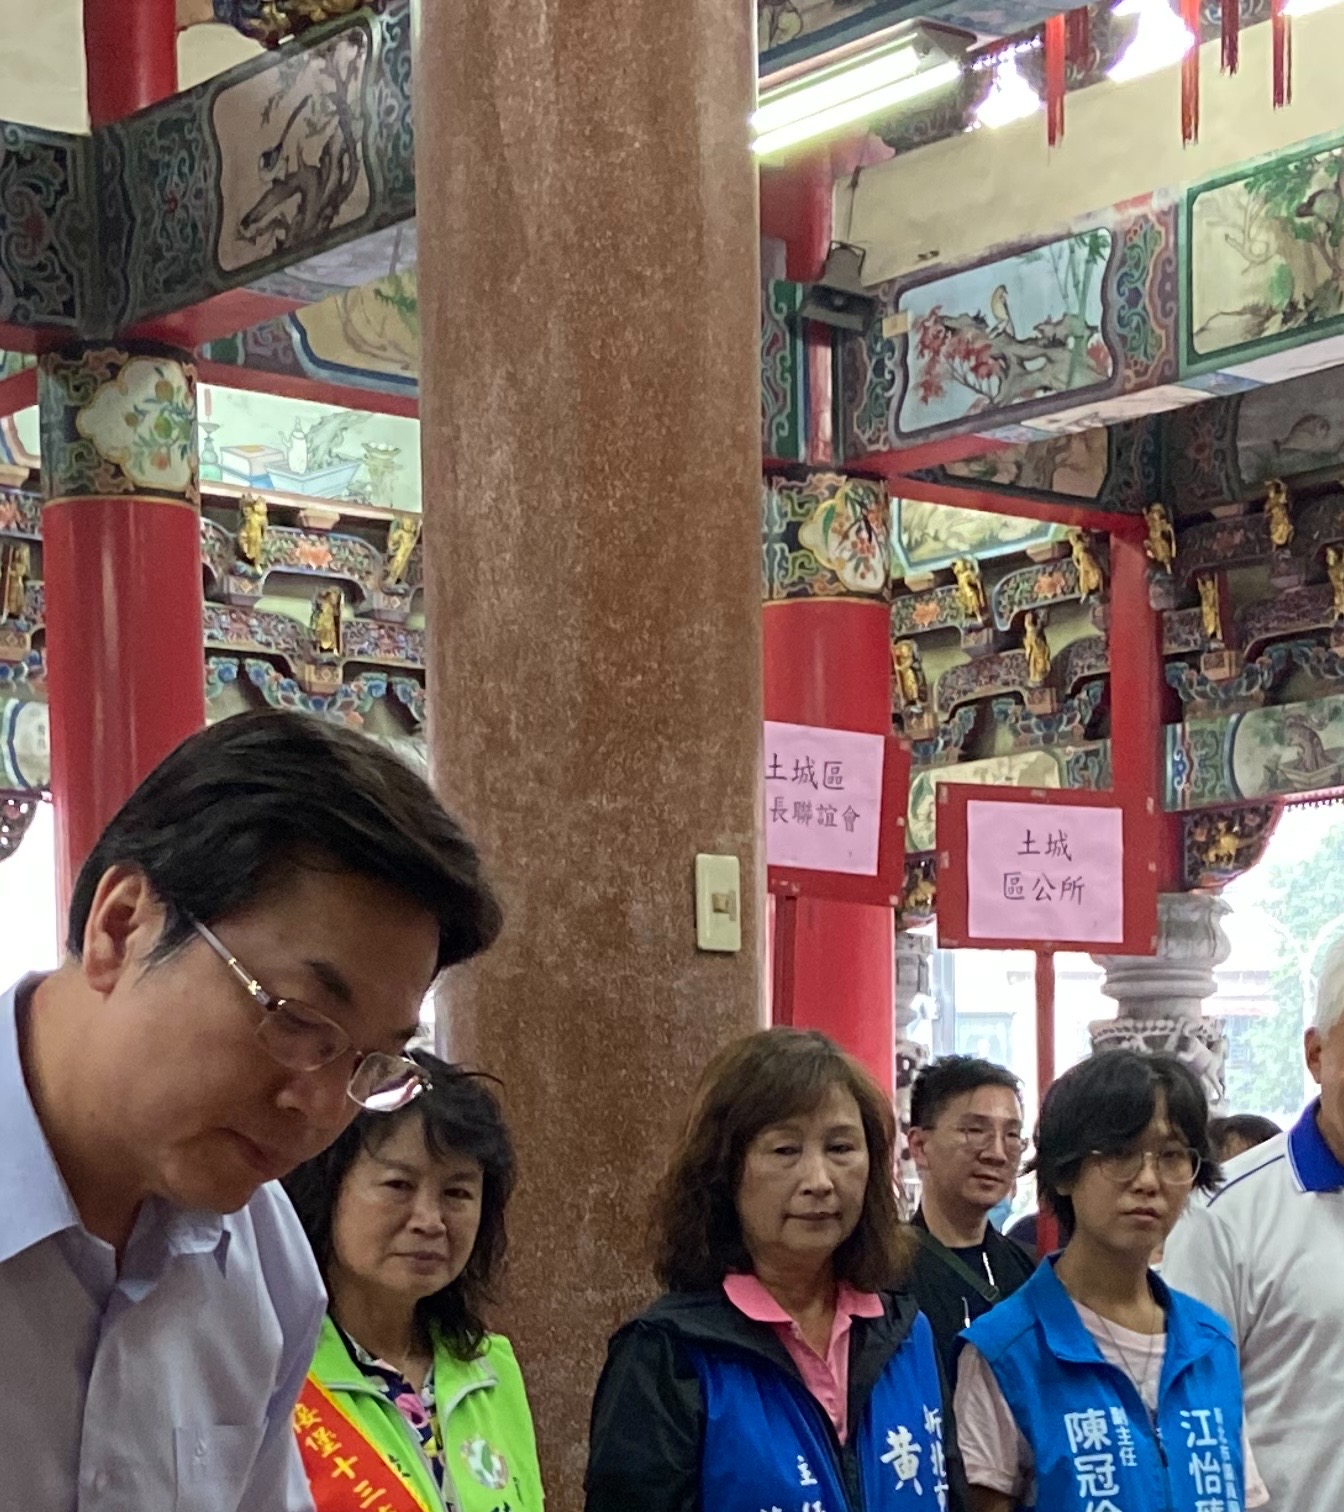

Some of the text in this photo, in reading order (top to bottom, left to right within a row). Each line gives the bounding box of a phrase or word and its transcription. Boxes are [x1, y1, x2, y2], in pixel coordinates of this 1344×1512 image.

[765, 752, 846, 791] 土城區
[769, 796, 861, 833] 長聯誼會
[1017, 829, 1072, 861] 土城
[1003, 871, 1085, 906] 區公所
